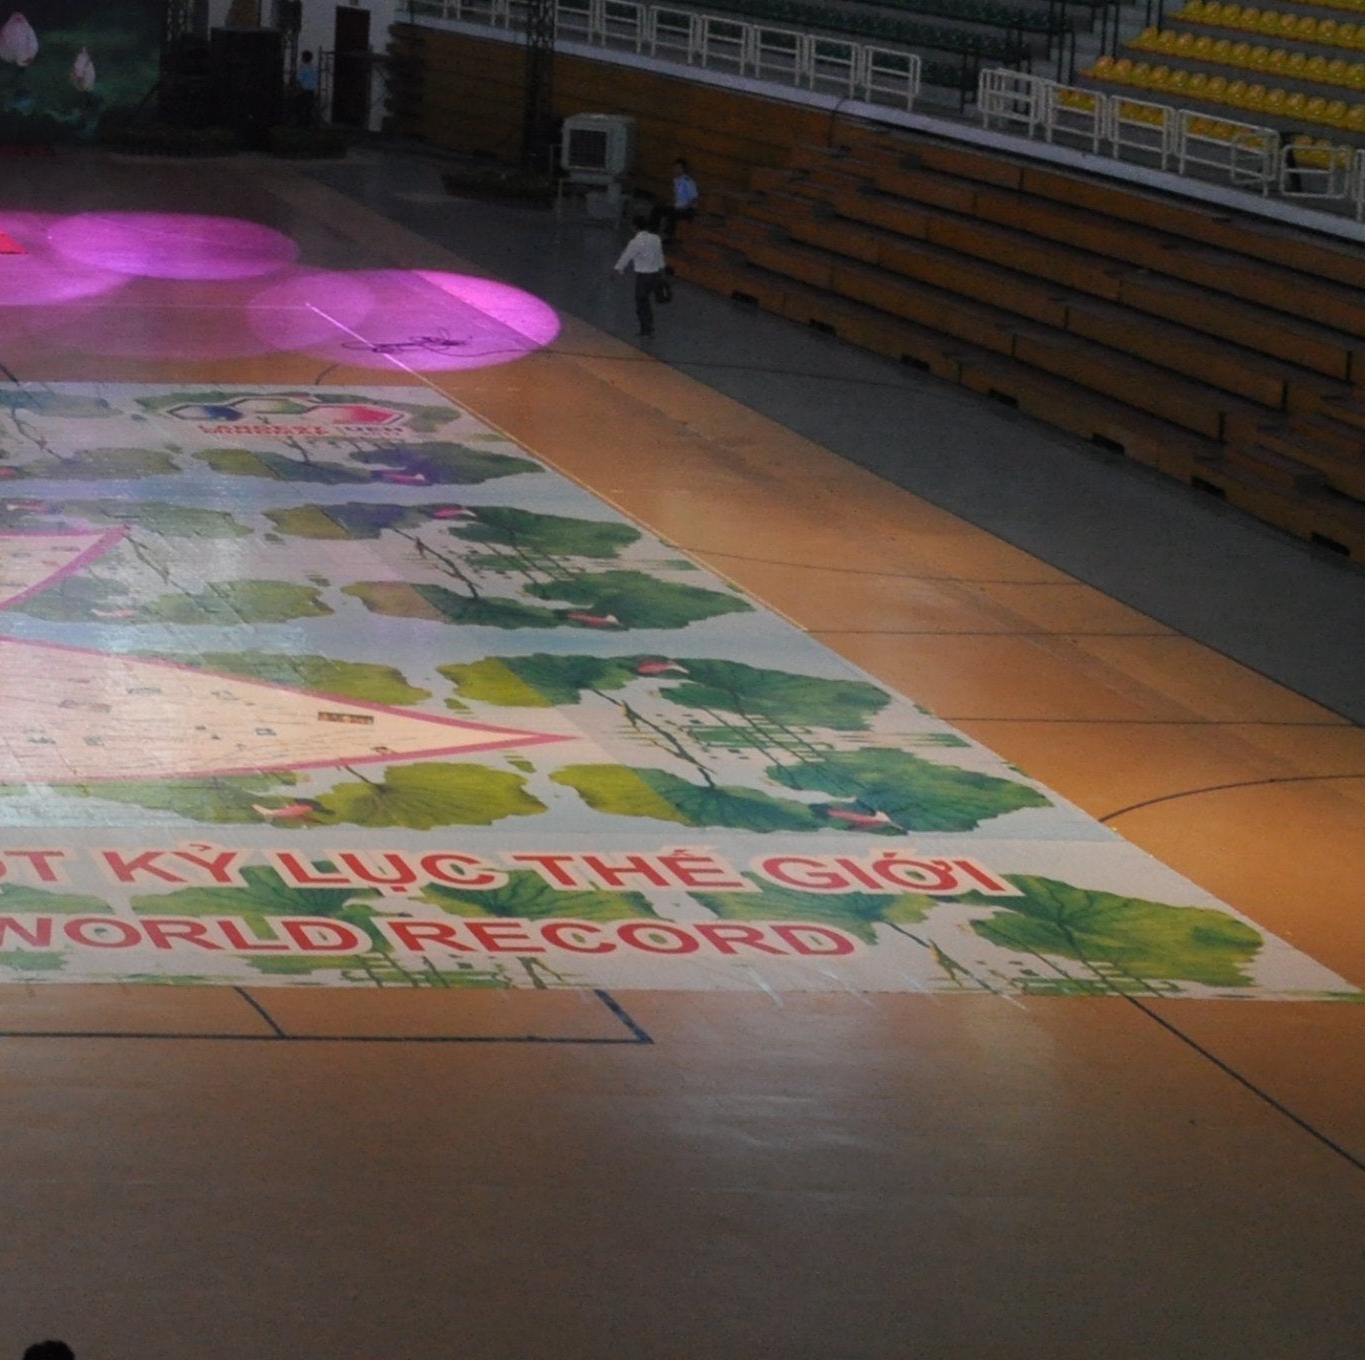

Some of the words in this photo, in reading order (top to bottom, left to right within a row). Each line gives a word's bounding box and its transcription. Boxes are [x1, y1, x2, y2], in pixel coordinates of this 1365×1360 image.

[102, 842, 239, 883] KỶ
[275, 853, 497, 893] LỤC
[512, 848, 745, 888] THẾ
[761, 851, 1007, 892] GIỚI
[386, 921, 855, 956] RECORD
